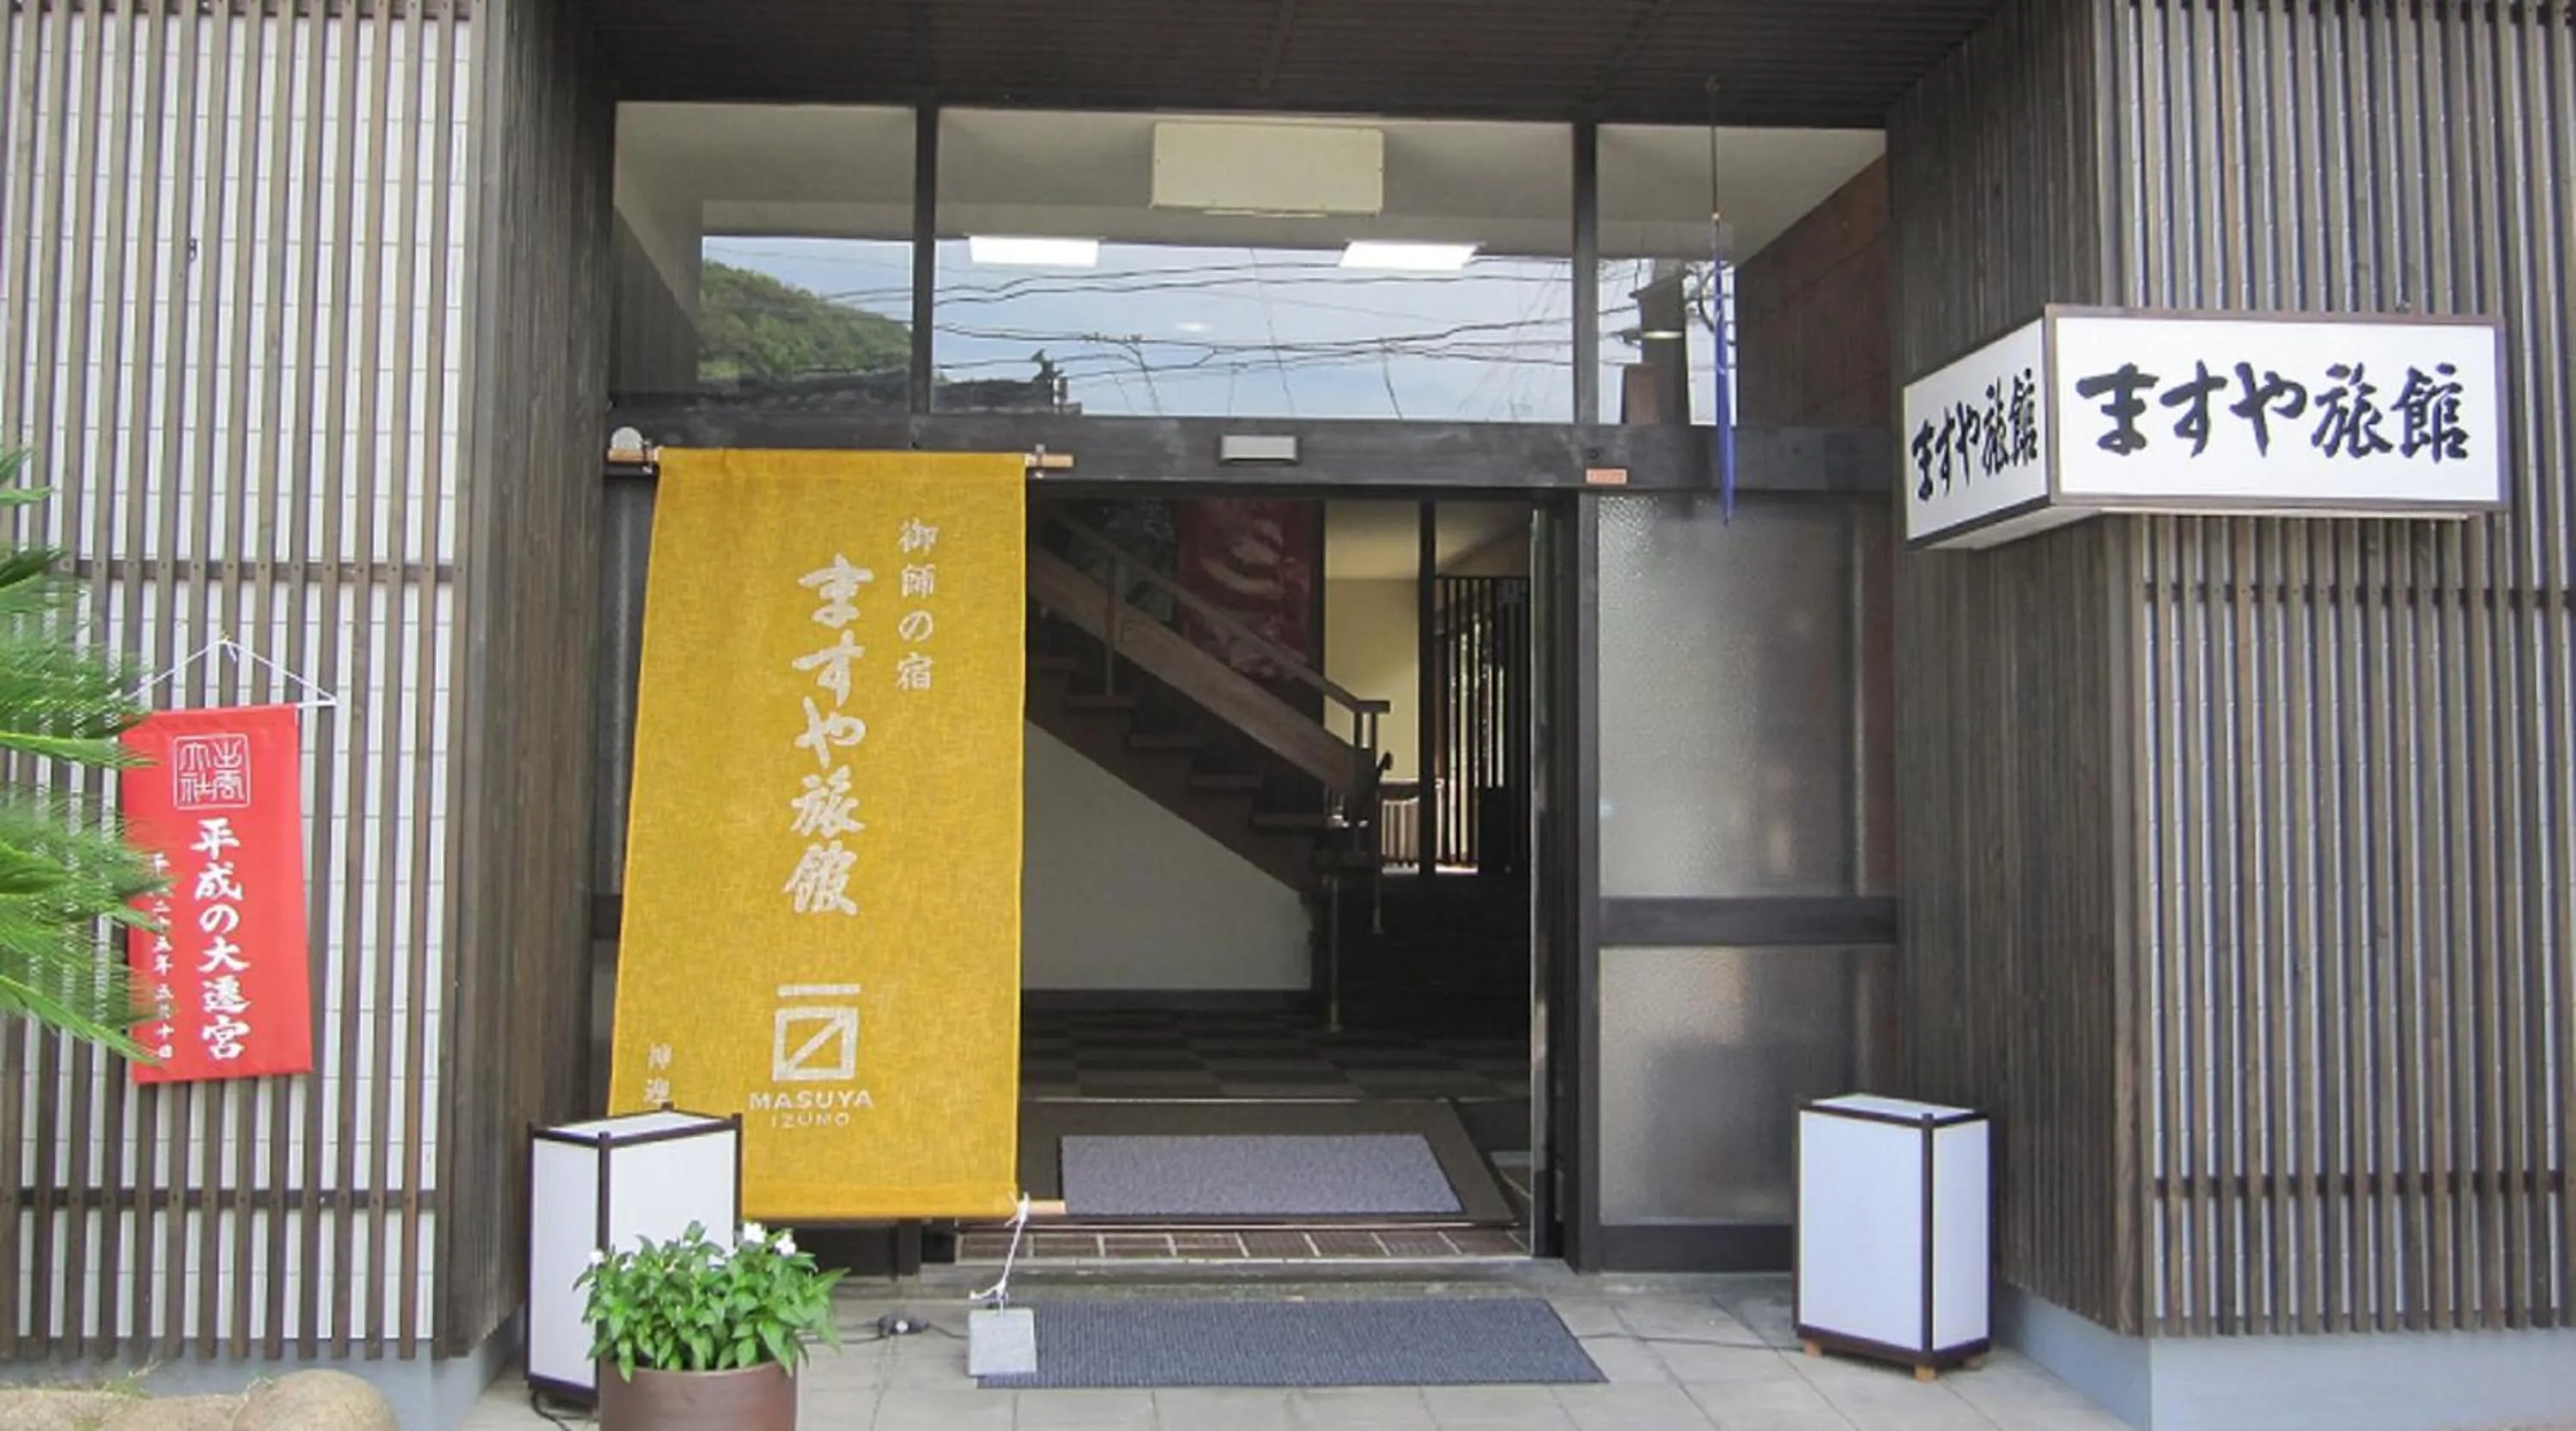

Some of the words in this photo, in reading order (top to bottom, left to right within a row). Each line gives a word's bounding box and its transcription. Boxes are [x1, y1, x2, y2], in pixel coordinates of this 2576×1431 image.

[1911, 369, 2038, 502] ますや旅館
[2076, 360, 2470, 462] ますや旅館
[897, 518, 939, 691] 御師の宿
[749, 1089, 874, 1111] MASUYA
[772, 1111, 850, 1129] IZUMO
